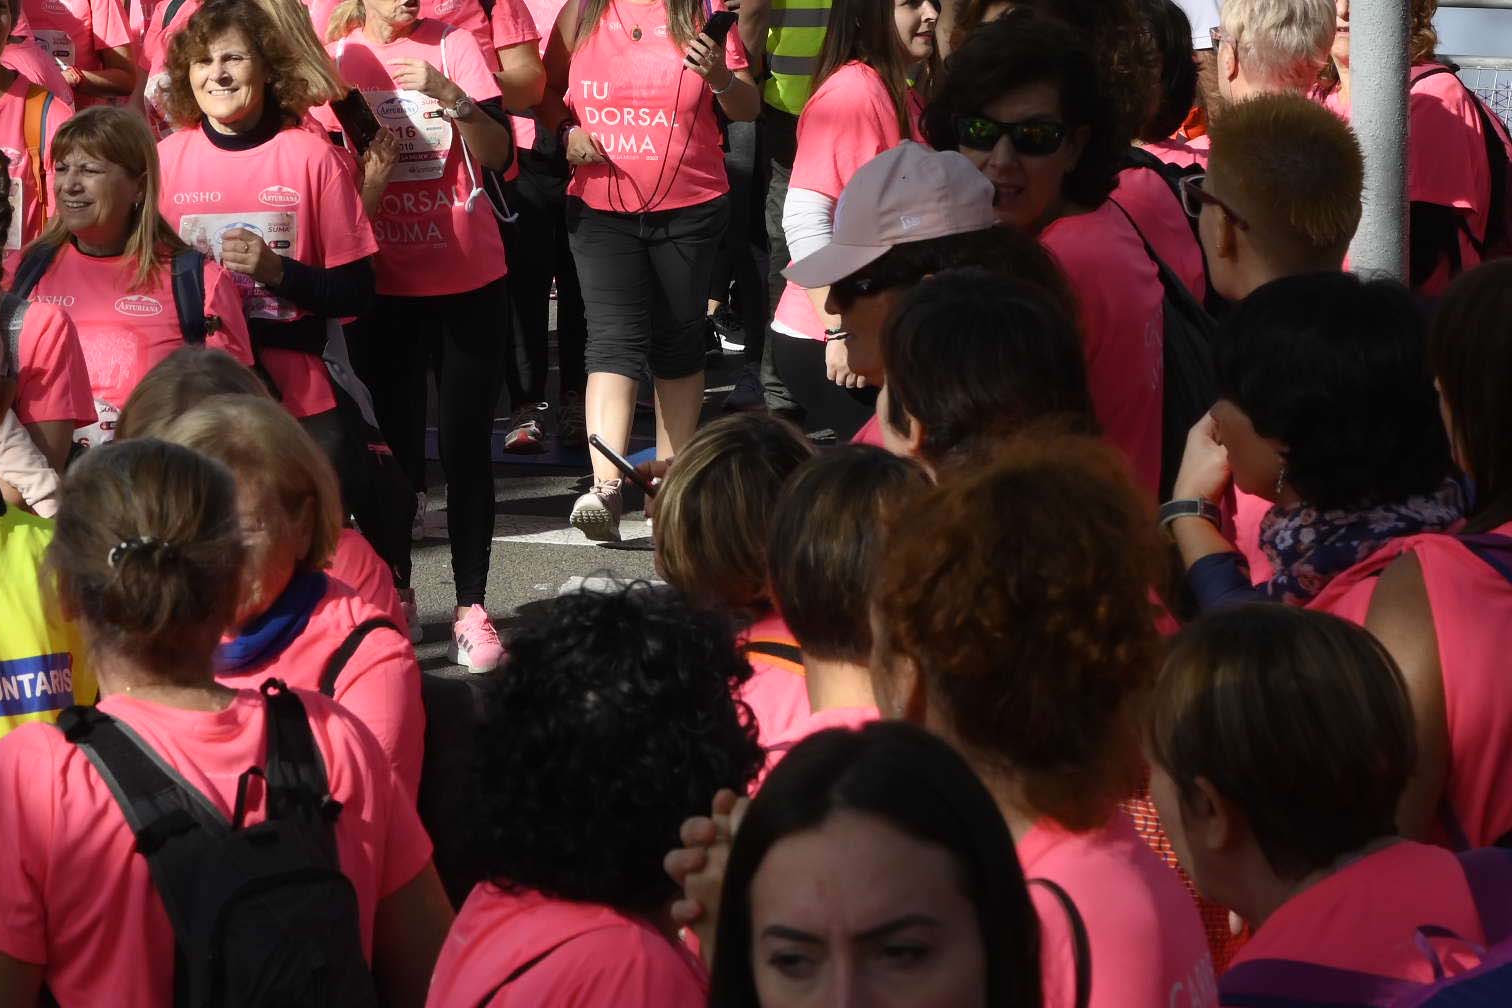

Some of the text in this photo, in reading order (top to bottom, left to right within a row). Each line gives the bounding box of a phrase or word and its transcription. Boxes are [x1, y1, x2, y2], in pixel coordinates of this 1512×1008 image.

[580, 80, 610, 99] TU
[584, 106, 680, 128] DORSAL
[394, 125, 416, 139] 16
[174, 191, 221, 205] OYSHO
[376, 184, 466, 215] ORSAL
[267, 224, 290, 233] SUMA
[33, 295, 76, 307] YSHO
